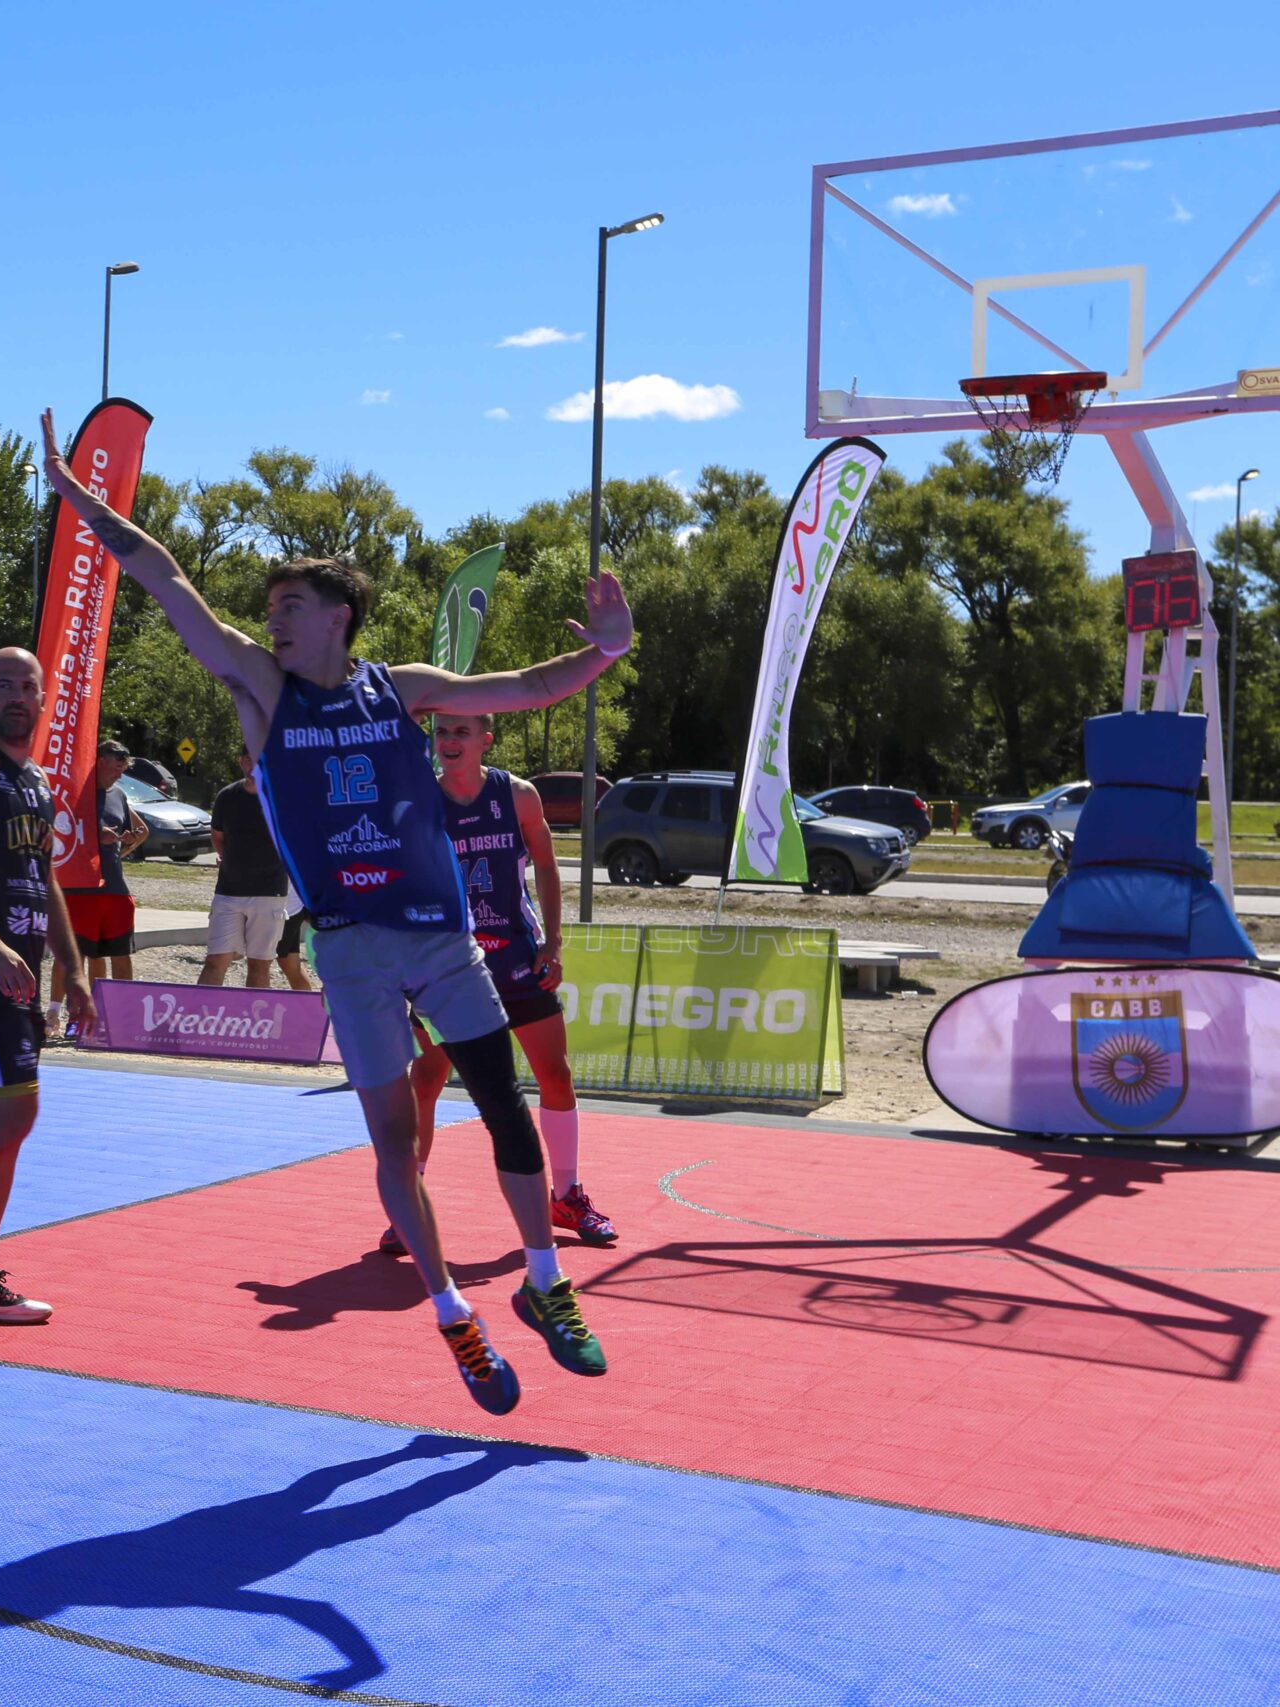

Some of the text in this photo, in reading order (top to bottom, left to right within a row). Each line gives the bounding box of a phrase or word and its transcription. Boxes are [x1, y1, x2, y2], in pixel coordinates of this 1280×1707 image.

[75, 447, 109, 547] Ngro
[65, 554, 92, 611] Río
[66, 615, 82, 646] de
[43, 652, 76, 776] Lotería
[60, 734, 74, 779] Para
[68, 672, 84, 728] Obras
[337, 718, 401, 747] BASKET
[323, 753, 379, 806] 12
[470, 832, 515, 852] BASKET
[340, 870, 389, 887] DOW
[141, 993, 275, 1040] Viedma
[1090, 998, 1163, 1018] CABB
